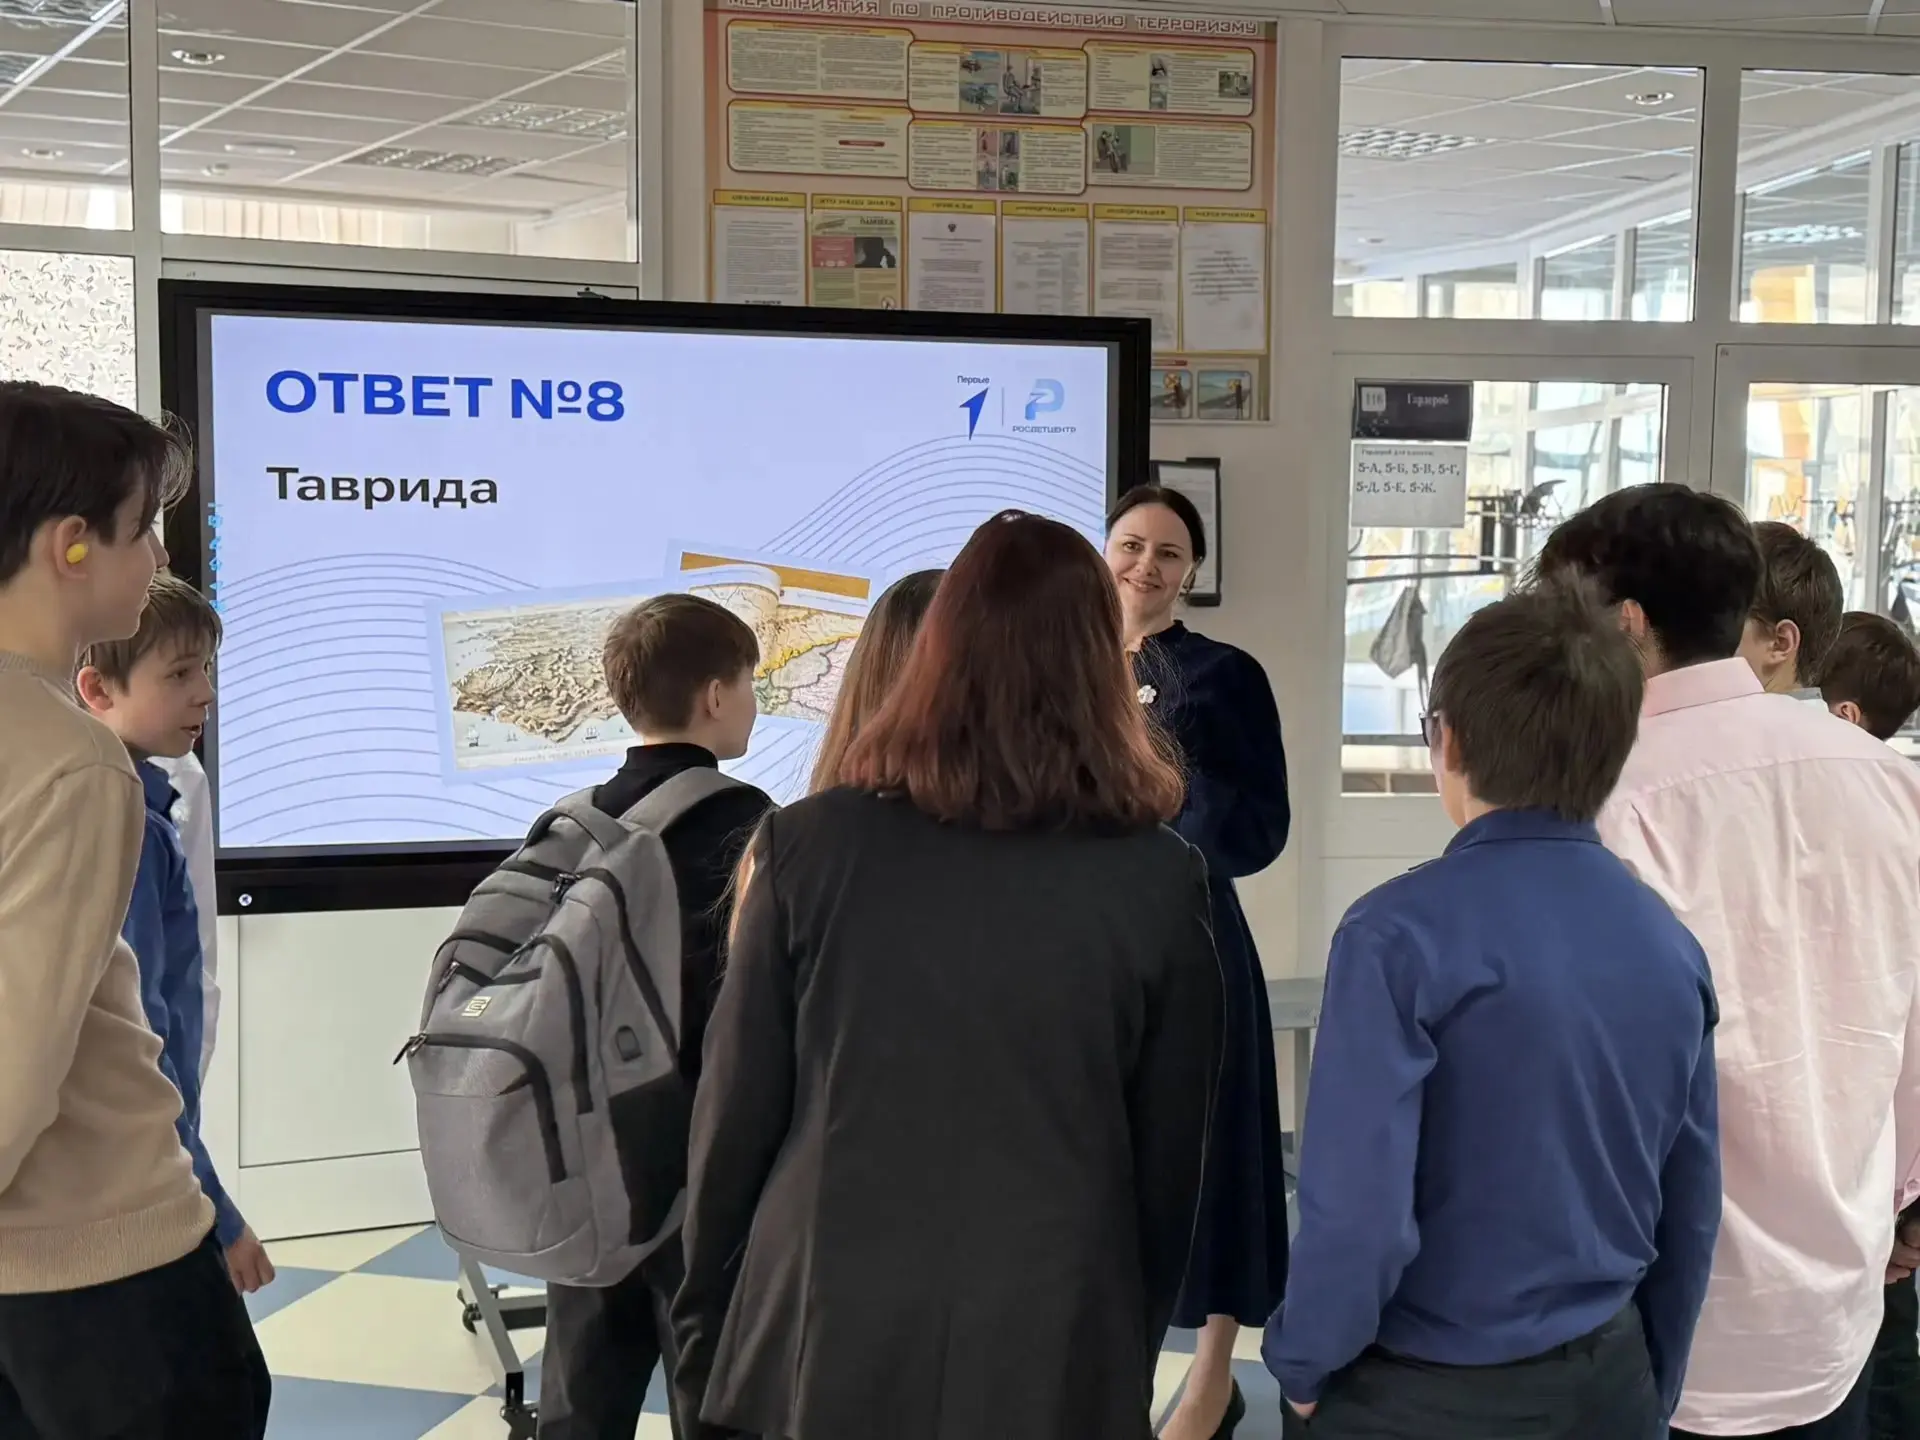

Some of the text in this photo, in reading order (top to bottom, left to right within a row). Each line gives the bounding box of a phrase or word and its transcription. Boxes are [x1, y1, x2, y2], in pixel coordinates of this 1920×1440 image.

[890, 2, 920, 16] ПО
[932, 4, 1126, 29] ПРОТИВОДЕЙСТВИЮ
[1136, 15, 1258, 35] ТЕРРОРИЗМУ
[956, 375, 991, 386] Первые
[266, 369, 626, 423] ОТВЕТ №8
[1407, 393, 1448, 407] Гардероб
[1357, 462, 1461, 476] 5-А, 5-Б, 5-В, 5-Г,
[266, 466, 499, 510] Таврида
